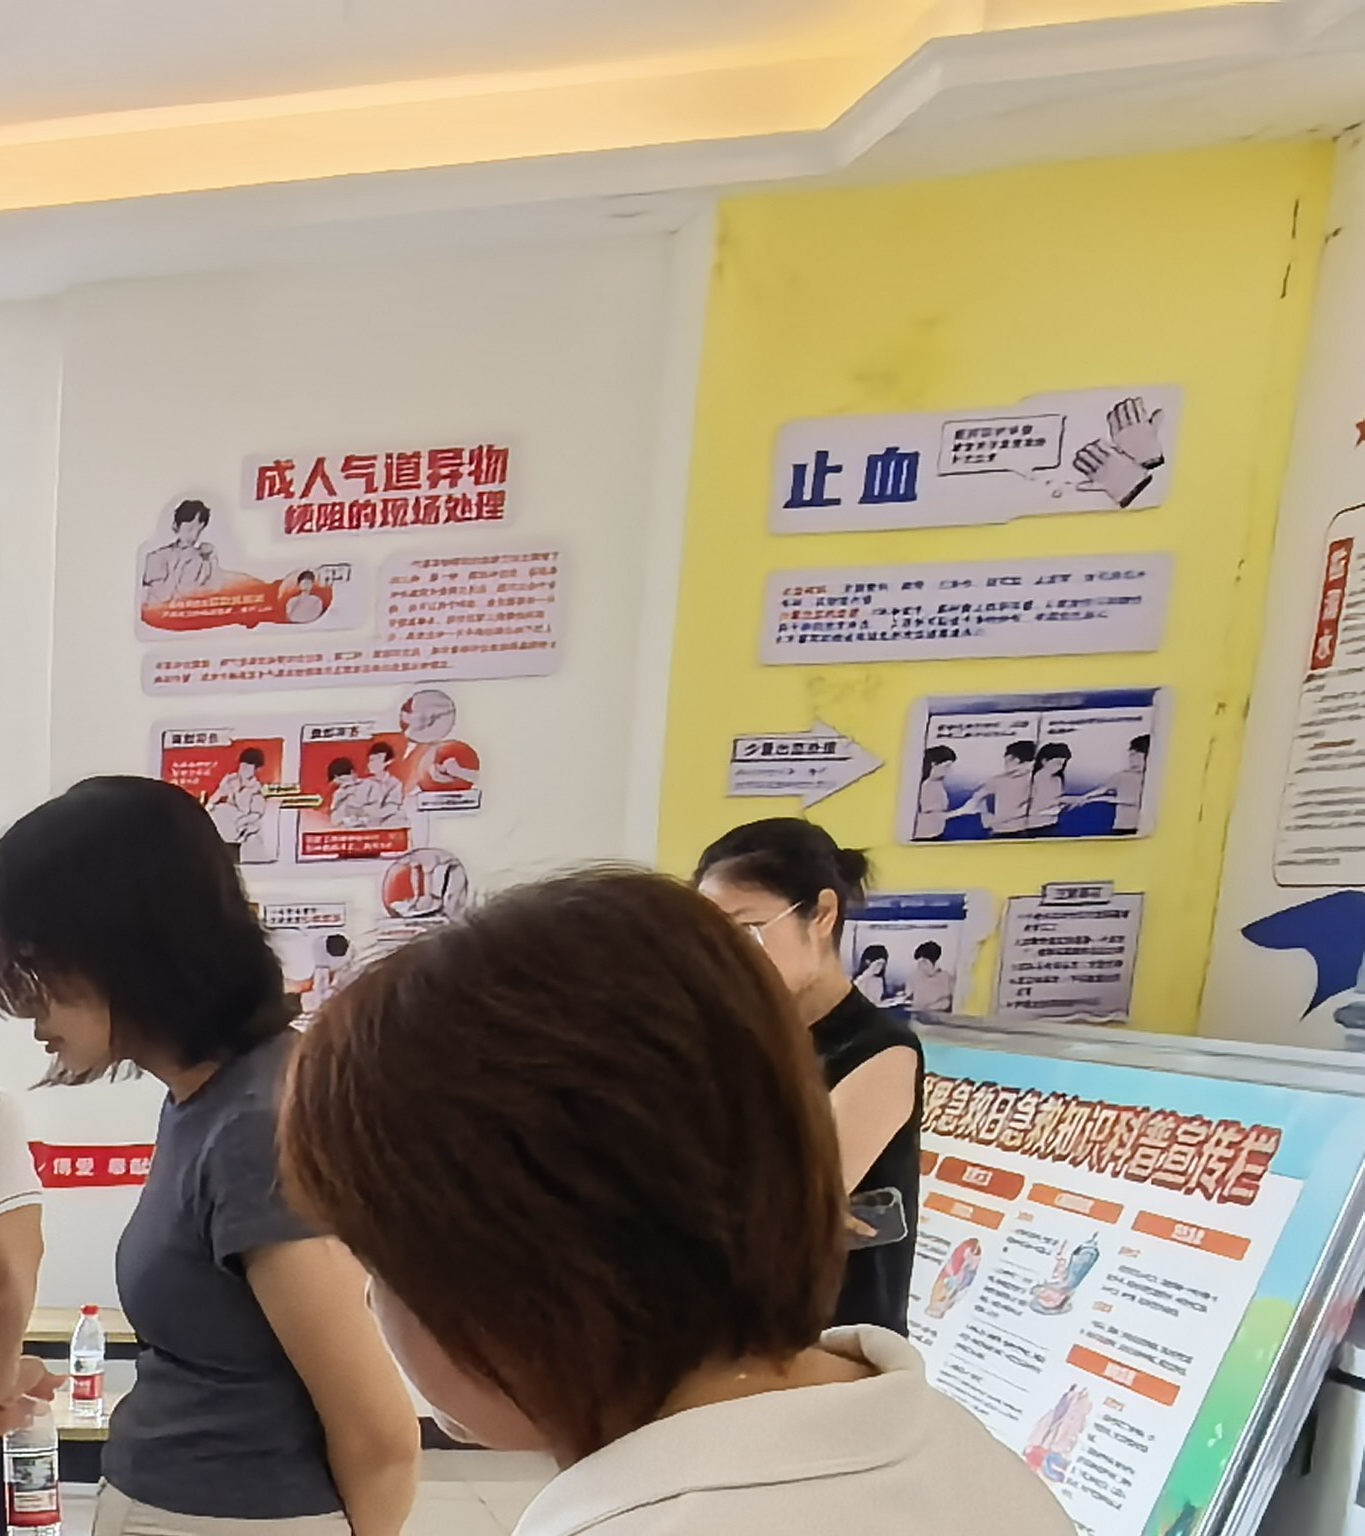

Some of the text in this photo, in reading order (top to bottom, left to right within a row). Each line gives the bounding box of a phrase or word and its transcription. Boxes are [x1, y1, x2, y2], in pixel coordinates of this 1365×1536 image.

[256, 446, 509, 500] 成人气道异物
[782, 446, 919, 509] 止血
[284, 490, 506, 535] 梗阻的现场处理
[920, 1070, 1281, 1206] 界急救日急救知识科普宣传栏
